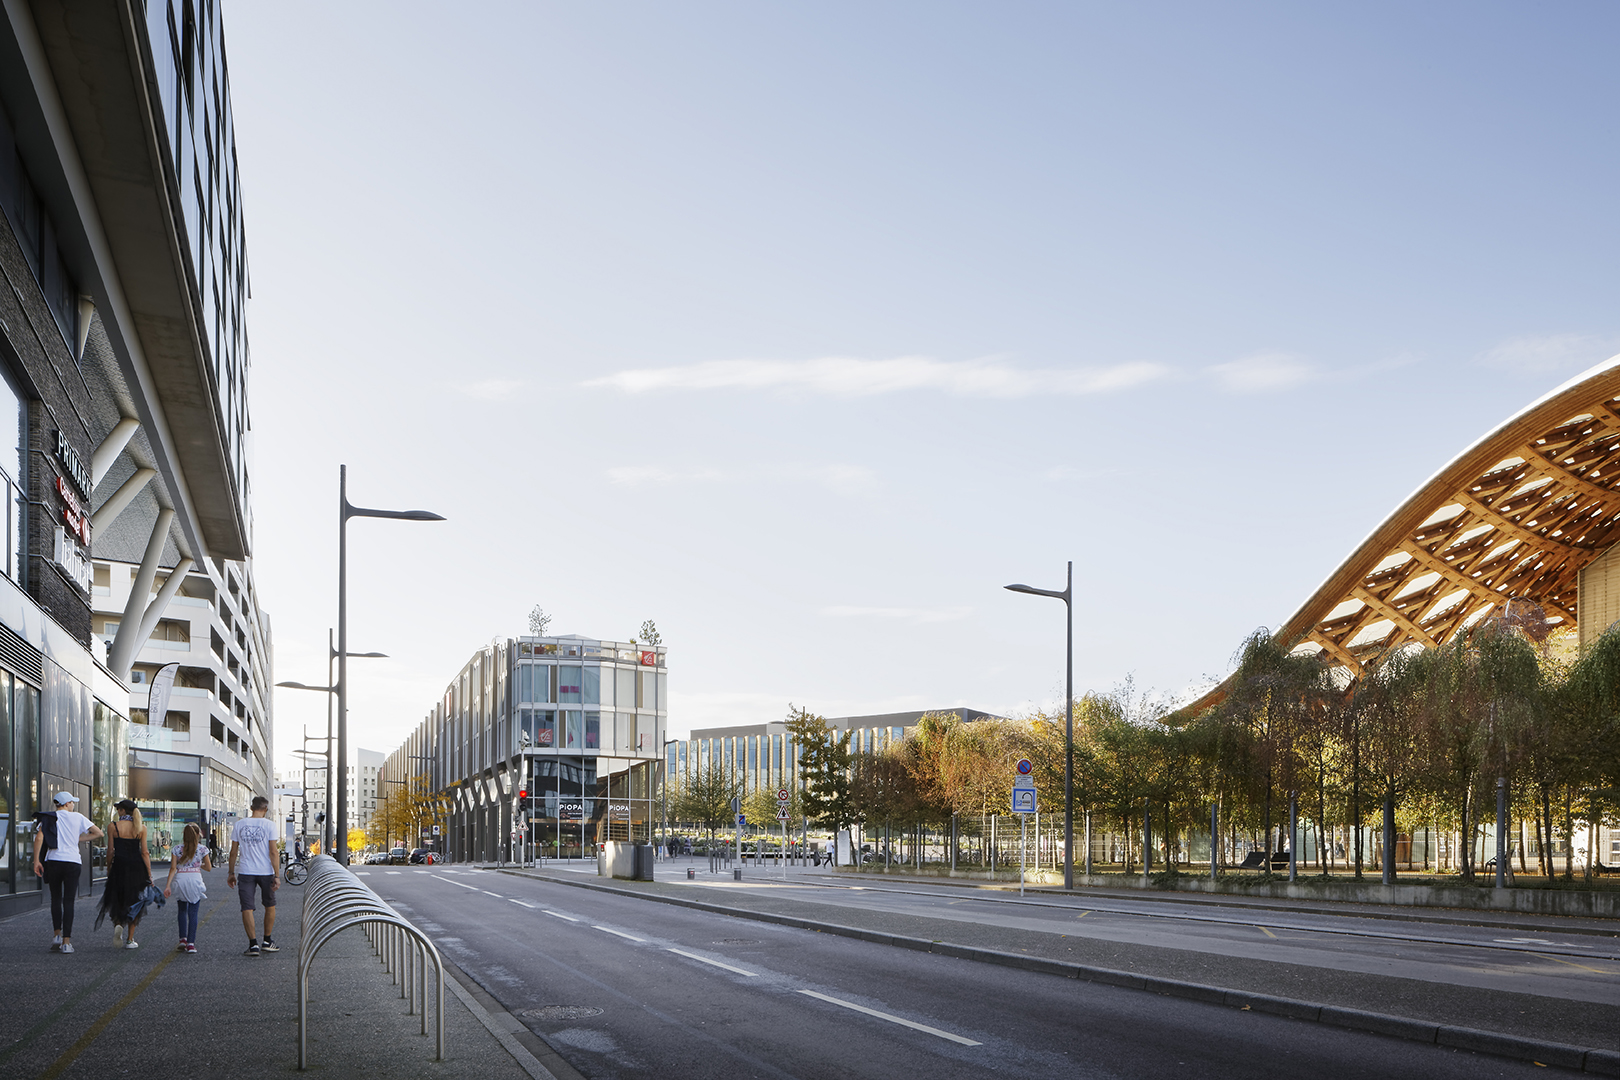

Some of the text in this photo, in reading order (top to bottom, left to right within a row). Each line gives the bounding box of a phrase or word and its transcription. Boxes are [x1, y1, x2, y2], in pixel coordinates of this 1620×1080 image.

[58, 430, 91, 503] PRIMARK
[57, 525, 91, 594] habitat
[150, 682, 162, 714] BRUNCH
